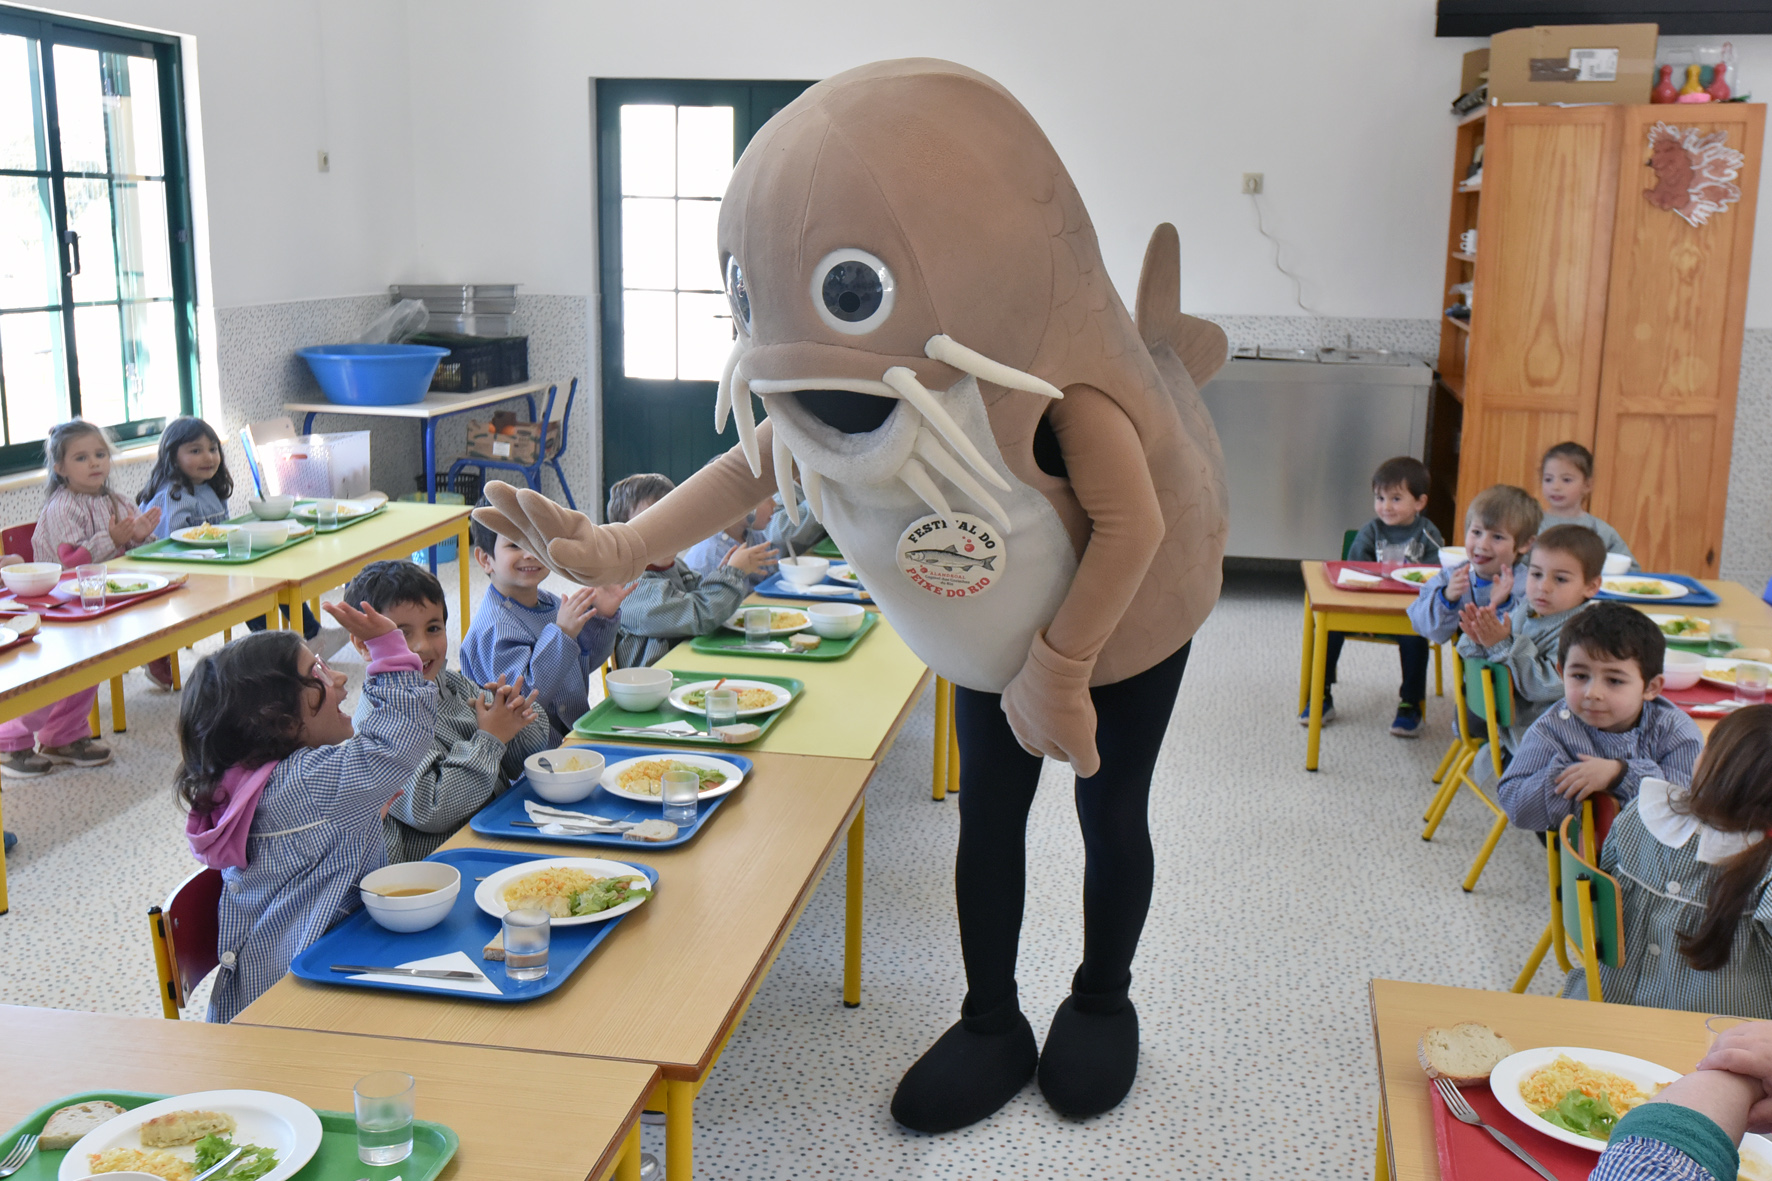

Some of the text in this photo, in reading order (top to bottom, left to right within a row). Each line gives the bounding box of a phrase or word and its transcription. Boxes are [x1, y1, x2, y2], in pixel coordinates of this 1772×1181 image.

[907, 520, 996, 549] FESTIAL DO
[905, 567, 944, 595] PEIXE
[946, 589, 966, 598] DO
[967, 577, 990, 594] RIO
